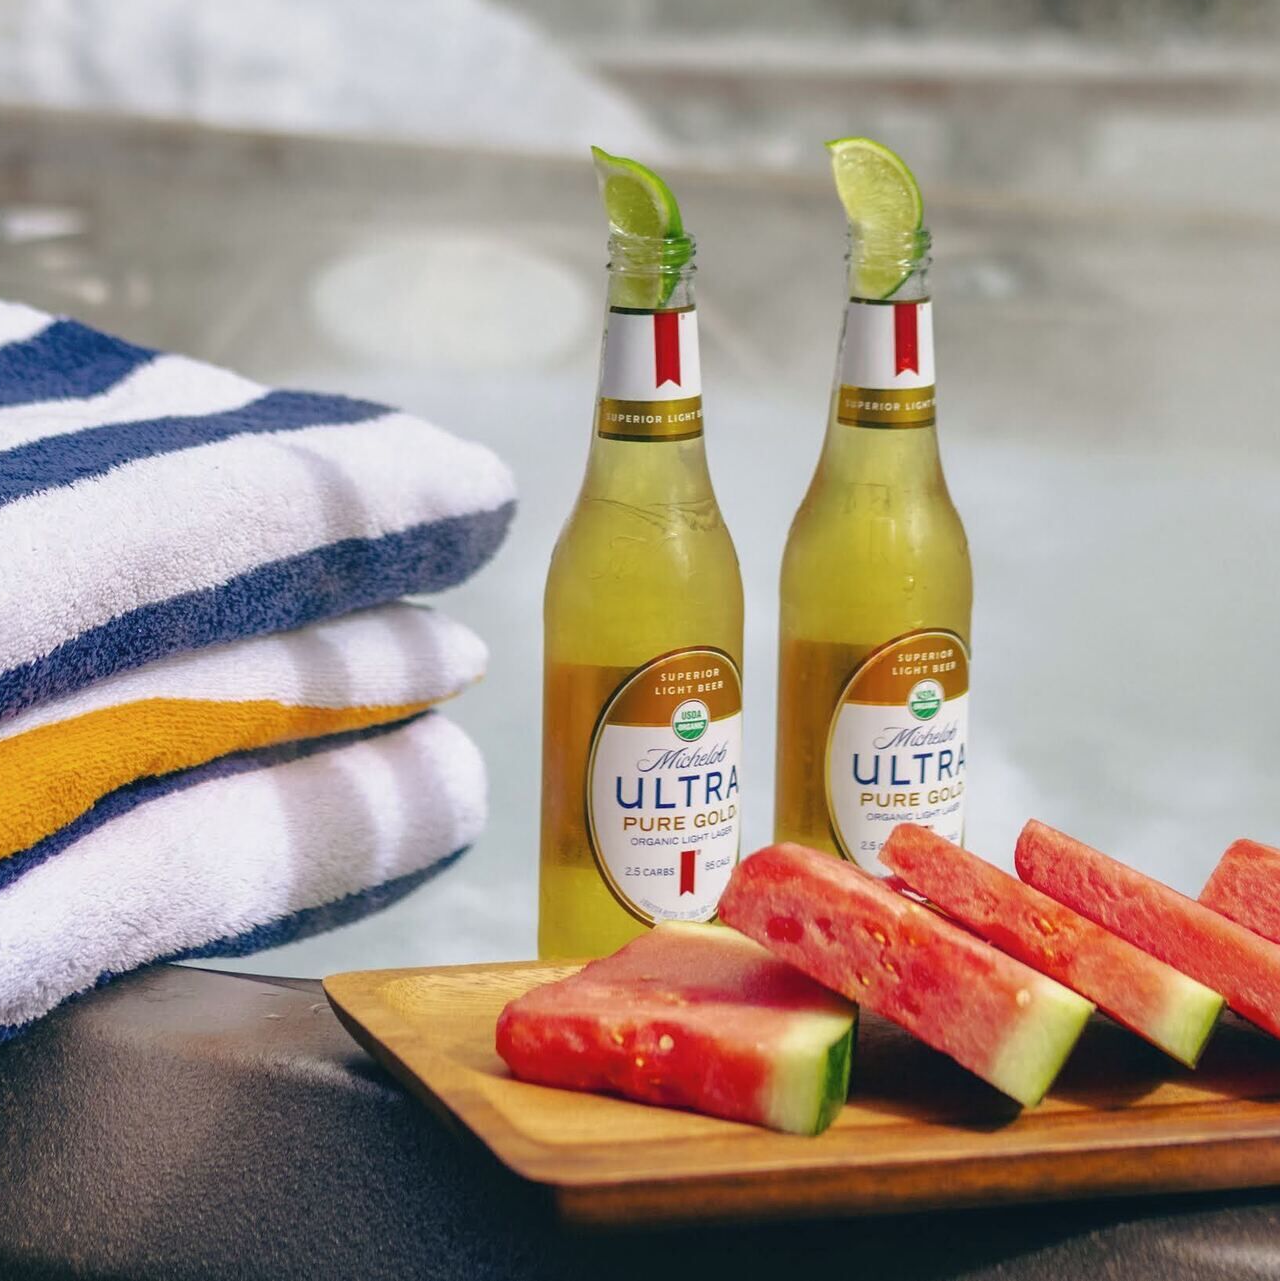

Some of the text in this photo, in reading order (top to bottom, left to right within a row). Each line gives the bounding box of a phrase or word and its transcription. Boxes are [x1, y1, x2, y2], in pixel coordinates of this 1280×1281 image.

[607, 412, 662, 423] SUPERIOR
[668, 411, 696, 423] LIGHT
[897, 649, 954, 663] SUPERIOR
[660, 668, 721, 682] SUPERIOR
[892, 661, 957, 676] LIGHT BEER
[655, 681, 724, 696] LIGHT BEER
[681, 710, 702, 721] USDA
[873, 721, 957, 750] Michelob
[637, 740, 728, 773] Michelob
[853, 743, 967, 786] ULTRA
[616, 765, 740, 809] ULTRA
[860, 792, 921, 808] PURE
[623, 805, 737, 832] PURE GOLD
[866, 812, 913, 821] ORGANIC
[631, 825, 733, 847] ORGANIC LIGHT LAGER
[625, 866, 675, 877] 2.5 CARBS
